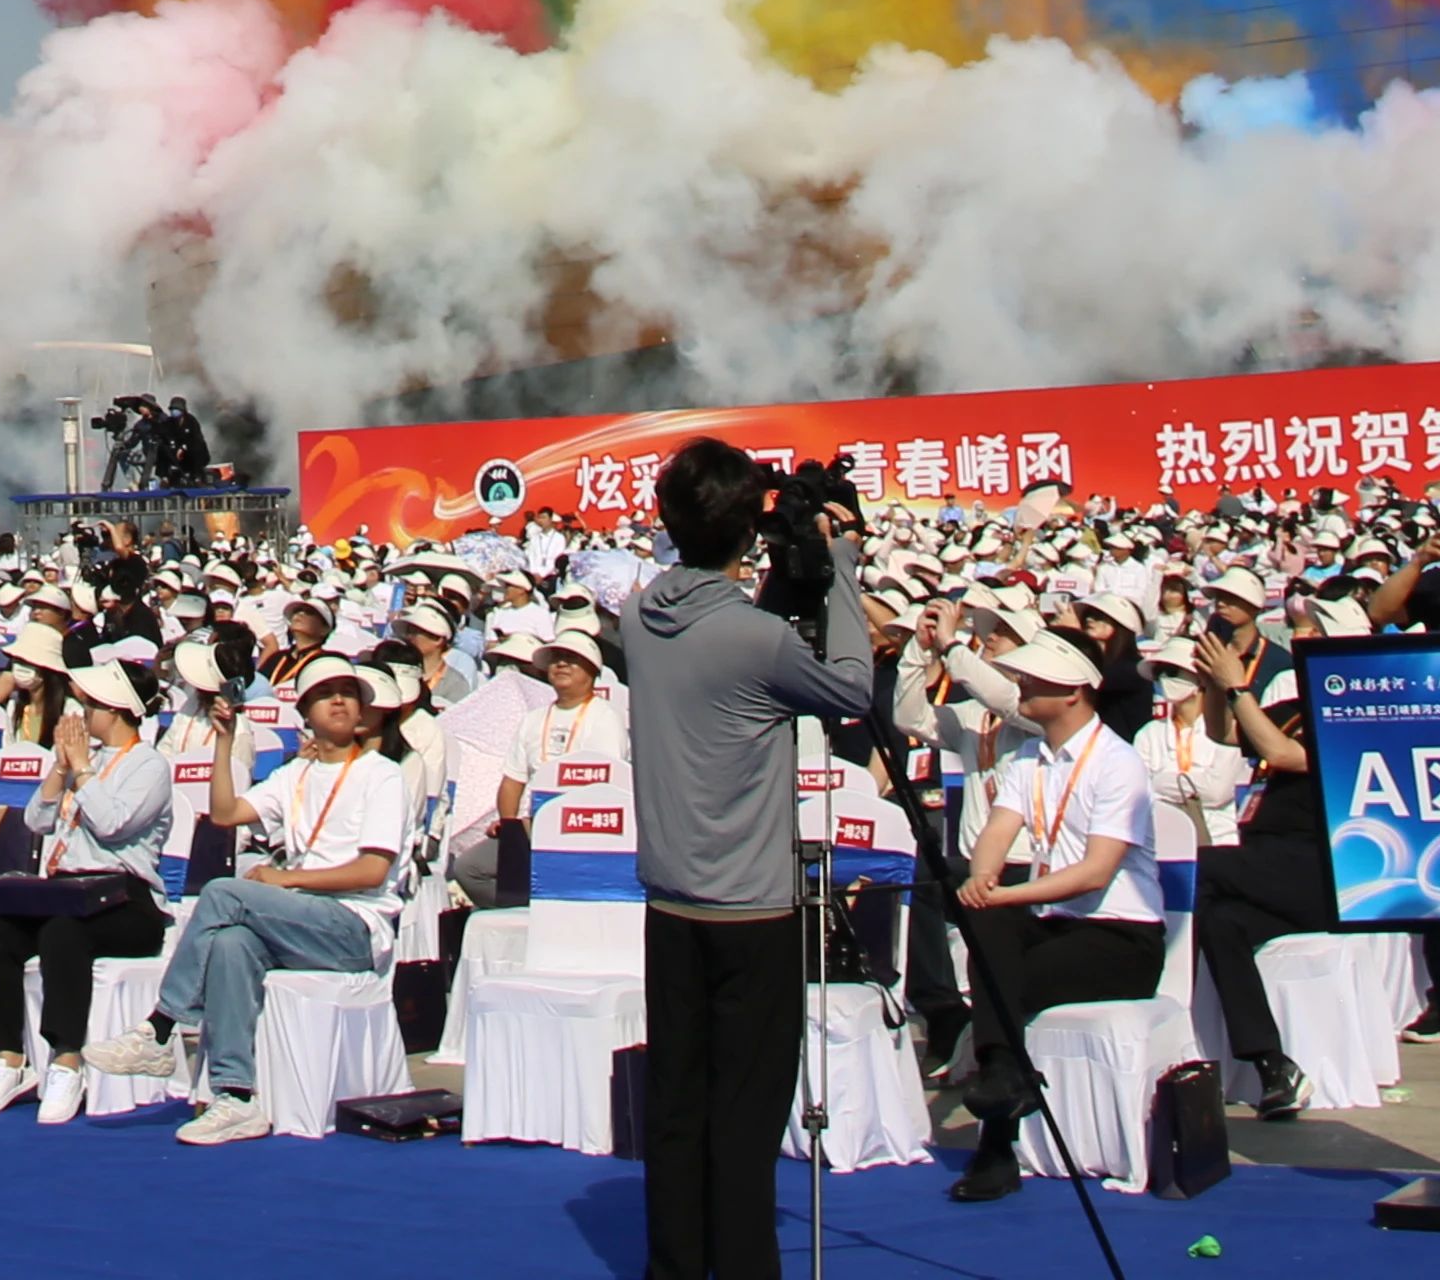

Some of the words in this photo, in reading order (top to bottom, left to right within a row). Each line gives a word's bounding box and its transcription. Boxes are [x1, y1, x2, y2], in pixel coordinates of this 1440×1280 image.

[836, 430, 1074, 502] 青春崤函
[562, 765, 608, 784] A1二排4号
[566, 810, 620, 830] A1一排3号
